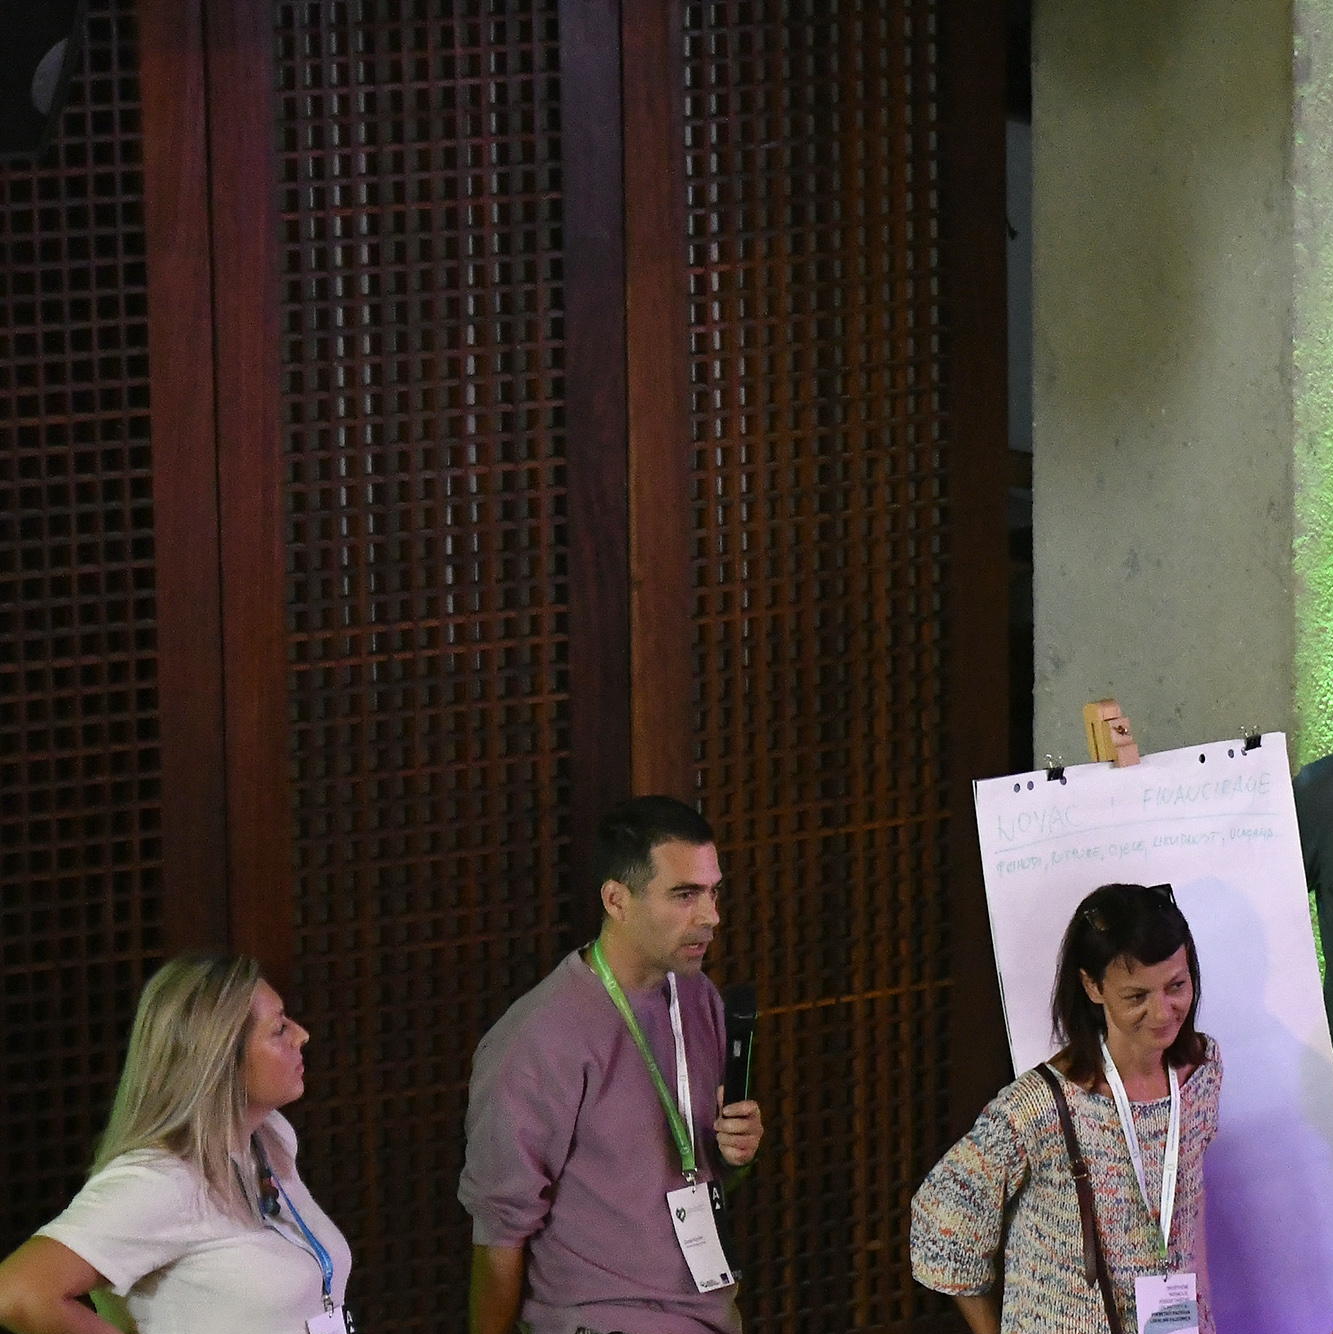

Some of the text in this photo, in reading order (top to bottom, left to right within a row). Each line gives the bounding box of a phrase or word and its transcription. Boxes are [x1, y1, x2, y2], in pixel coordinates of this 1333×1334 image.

[996, 804, 1082, 843] NOVAC
[712, 1187, 720, 1200] A
[346, 1310, 354, 1325] A
